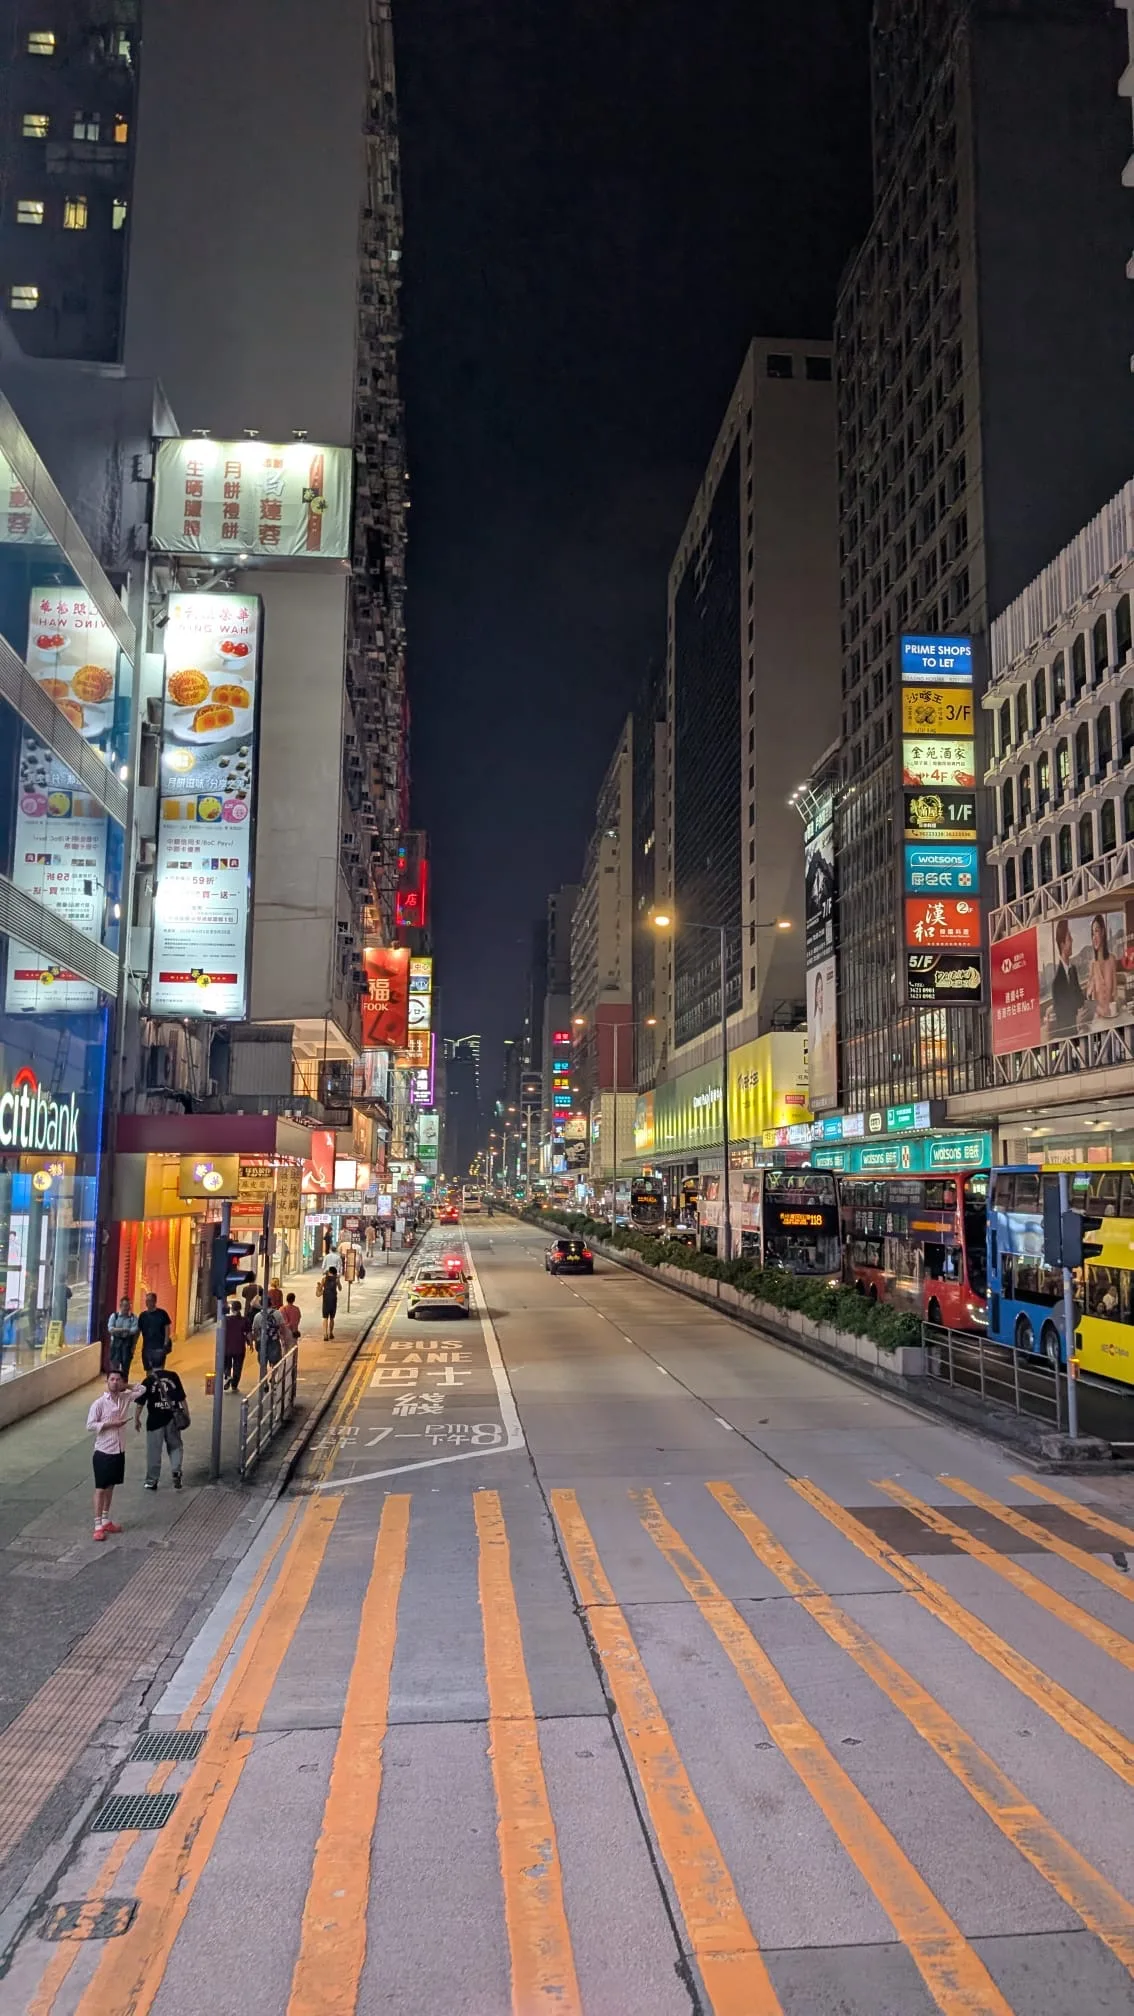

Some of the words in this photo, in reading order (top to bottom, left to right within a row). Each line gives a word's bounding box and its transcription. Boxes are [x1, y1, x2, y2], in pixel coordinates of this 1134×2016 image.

[222, 461, 241, 539] 月餅禮餅
[220, 625, 249, 635] WAH
[905, 644, 935, 655] PRIME
[938, 645, 971, 656] SHOPS
[922, 657, 936, 667] TO
[939, 658, 954, 668] LET
[945, 705, 971, 721] 3/F
[912, 747, 966, 760] 金苑酒家
[931, 769, 948, 782] 4F
[948, 804, 973, 821] 1/F
[919, 855, 963, 864] watsons
[912, 872, 952, 886] 屈臣氏
[909, 955, 933, 968] 5/F
[368, 979, 390, 1002] 福
[363, 1002, 389, 1011] FOOK
[0, 1082, 79, 1153] citibank
[863, 1154, 884, 1165] watsons
[934, 1148, 961, 1160] watsons
[810, 1214, 822, 1226] 118
[390, 1340, 463, 1350] BUS
[376, 1352, 473, 1364] LANE
[369, 1366, 472, 1388] 巴士
[364, 1427, 394, 1447] 7
[470, 1424, 502, 1445] 8
[424, 1434, 471, 1446] 下午
